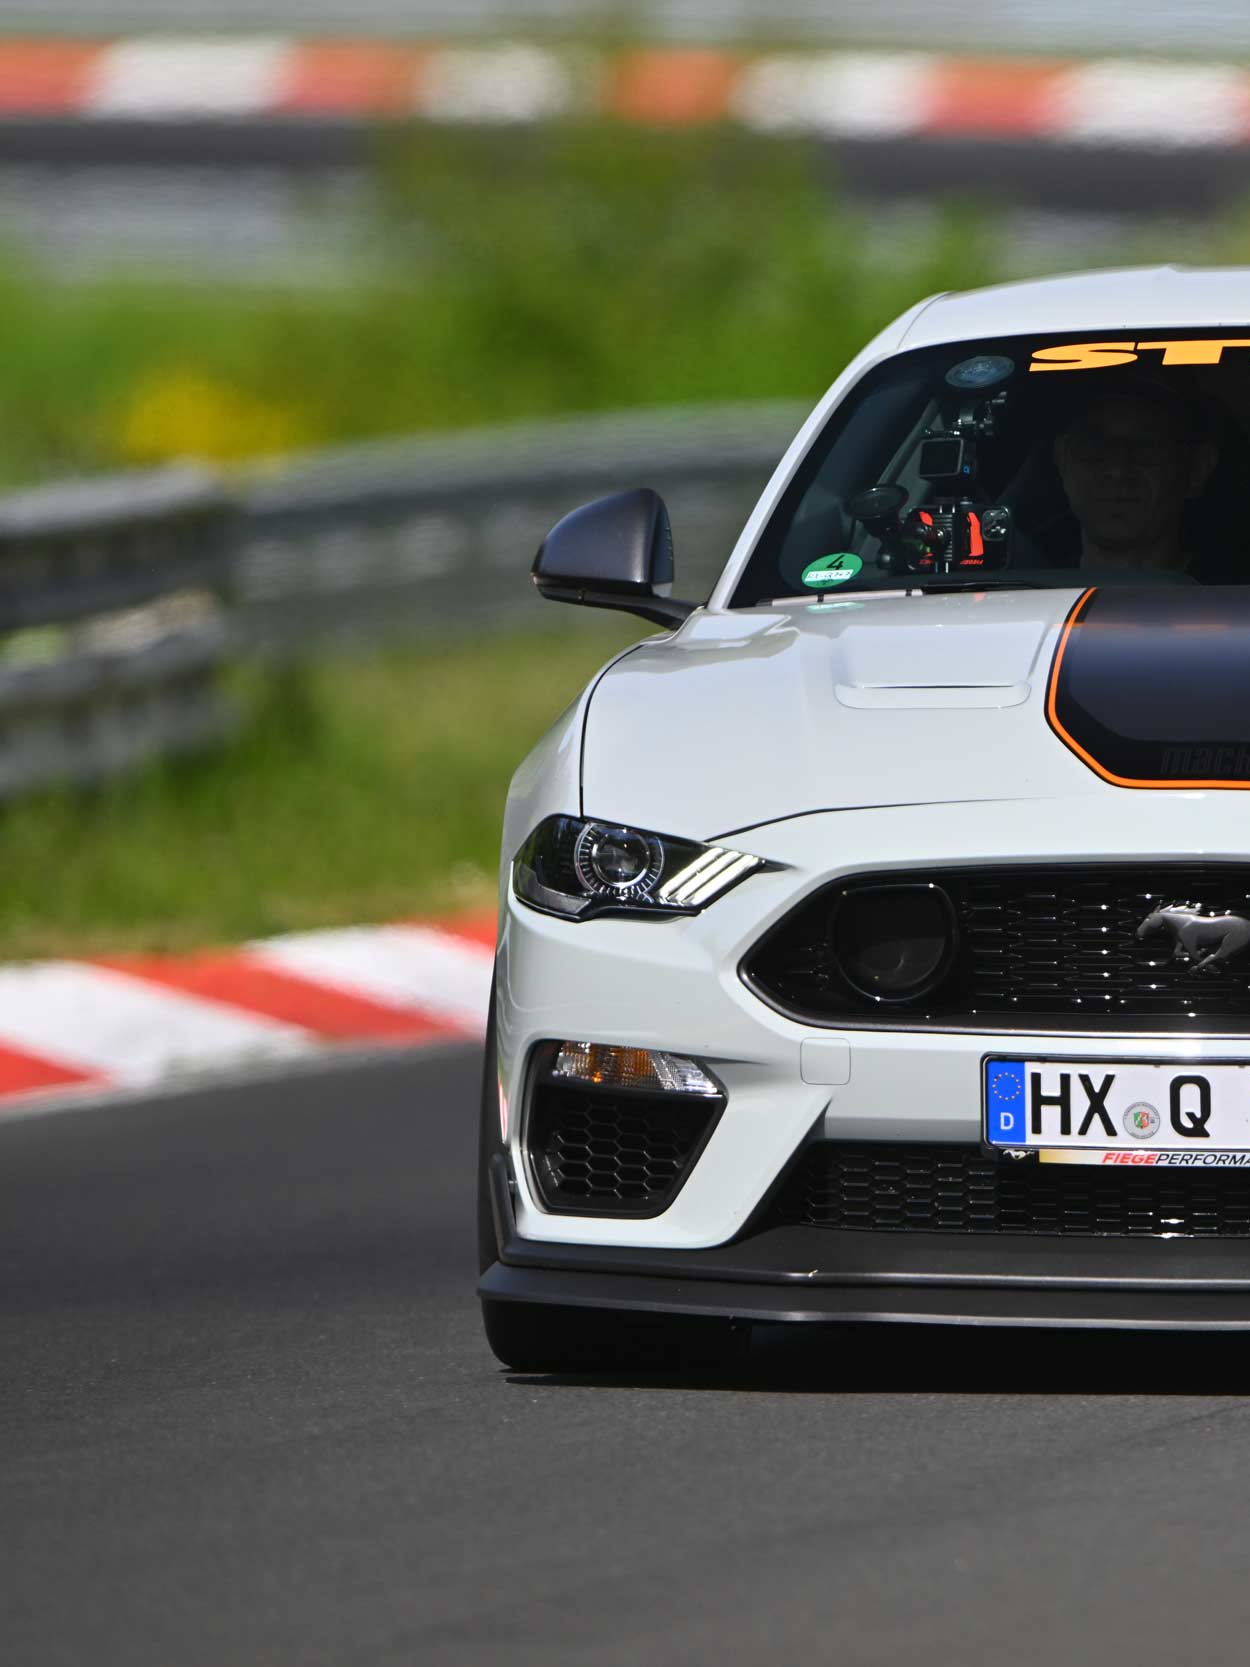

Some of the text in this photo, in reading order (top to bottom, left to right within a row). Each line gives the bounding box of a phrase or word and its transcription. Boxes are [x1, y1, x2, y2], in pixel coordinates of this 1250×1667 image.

[826, 554, 845, 570] 4
[1030, 1072, 1118, 1137] HX
[1169, 1075, 1212, 1138] Q
[1000, 1112, 1015, 1130] D
